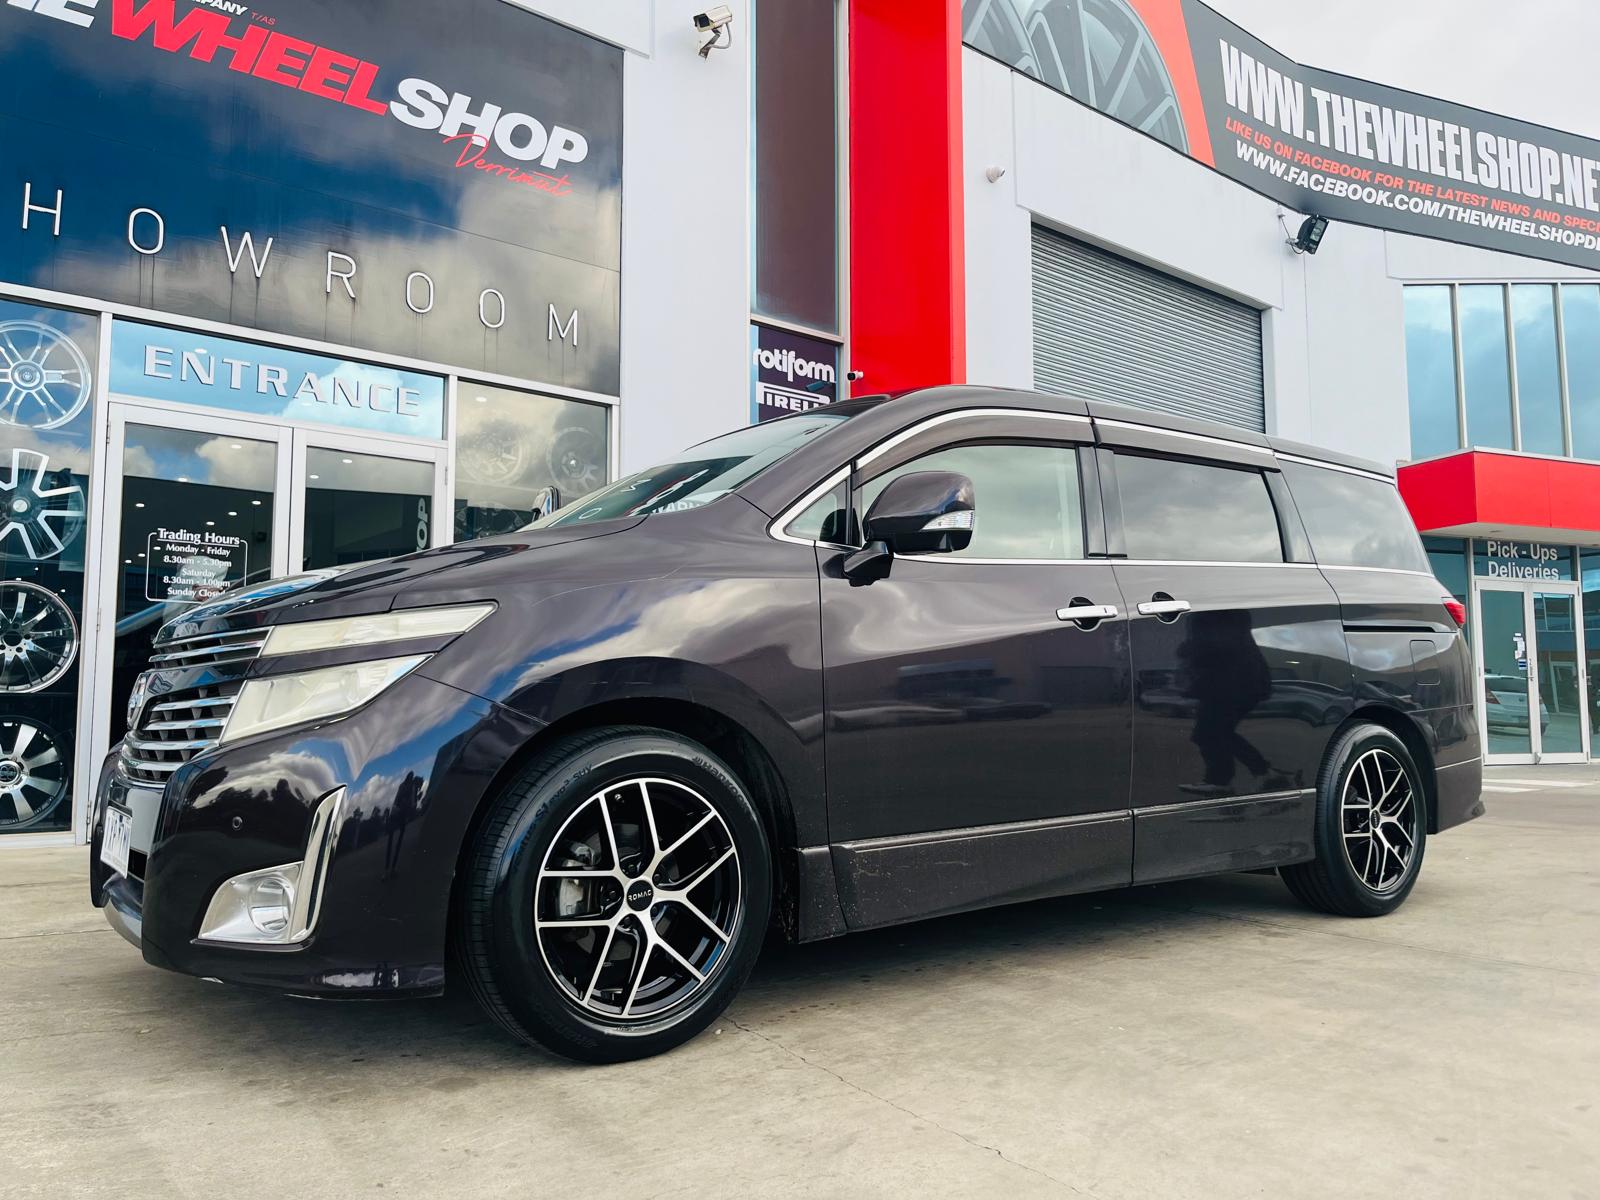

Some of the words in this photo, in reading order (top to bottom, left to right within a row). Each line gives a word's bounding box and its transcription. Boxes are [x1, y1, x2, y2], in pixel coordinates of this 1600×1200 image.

[251, 11, 276, 25] T/AS
[112, 0, 388, 116] WHEEL
[389, 78, 589, 169] SHOP
[1225, 116, 1252, 140] LIKE
[1254, 132, 1272, 150] US
[1273, 141, 1292, 160] ON
[1294, 150, 1373, 182] FACEBOOK
[1374, 172, 1404, 190] FOR
[1407, 179, 1434, 196] THE
[1436, 186, 1488, 207] LATEST
[1491, 199, 1530, 218] NEWS
[1533, 208, 1561, 224] AND
[752, 348, 836, 383] rotiform
[143, 344, 421, 417] ENTRANCE
[157, 527, 201, 545] Trading
[205, 532, 240, 545] Hours
[166, 543, 199, 555] Monday
[207, 546, 231, 557] Friday
[1487, 541, 1519, 558] Pick
[1530, 543, 1558, 564] Ups
[163, 555, 194, 565] 8.30am
[203, 558, 232, 568] 5.30pm
[182, 568, 216, 579] Saturday
[1488, 561, 1559, 580] Deliveries
[163, 576, 194, 584] 8.30am
[167, 587, 197, 597] Sunday
[628, 889, 652, 902] ROMAC
